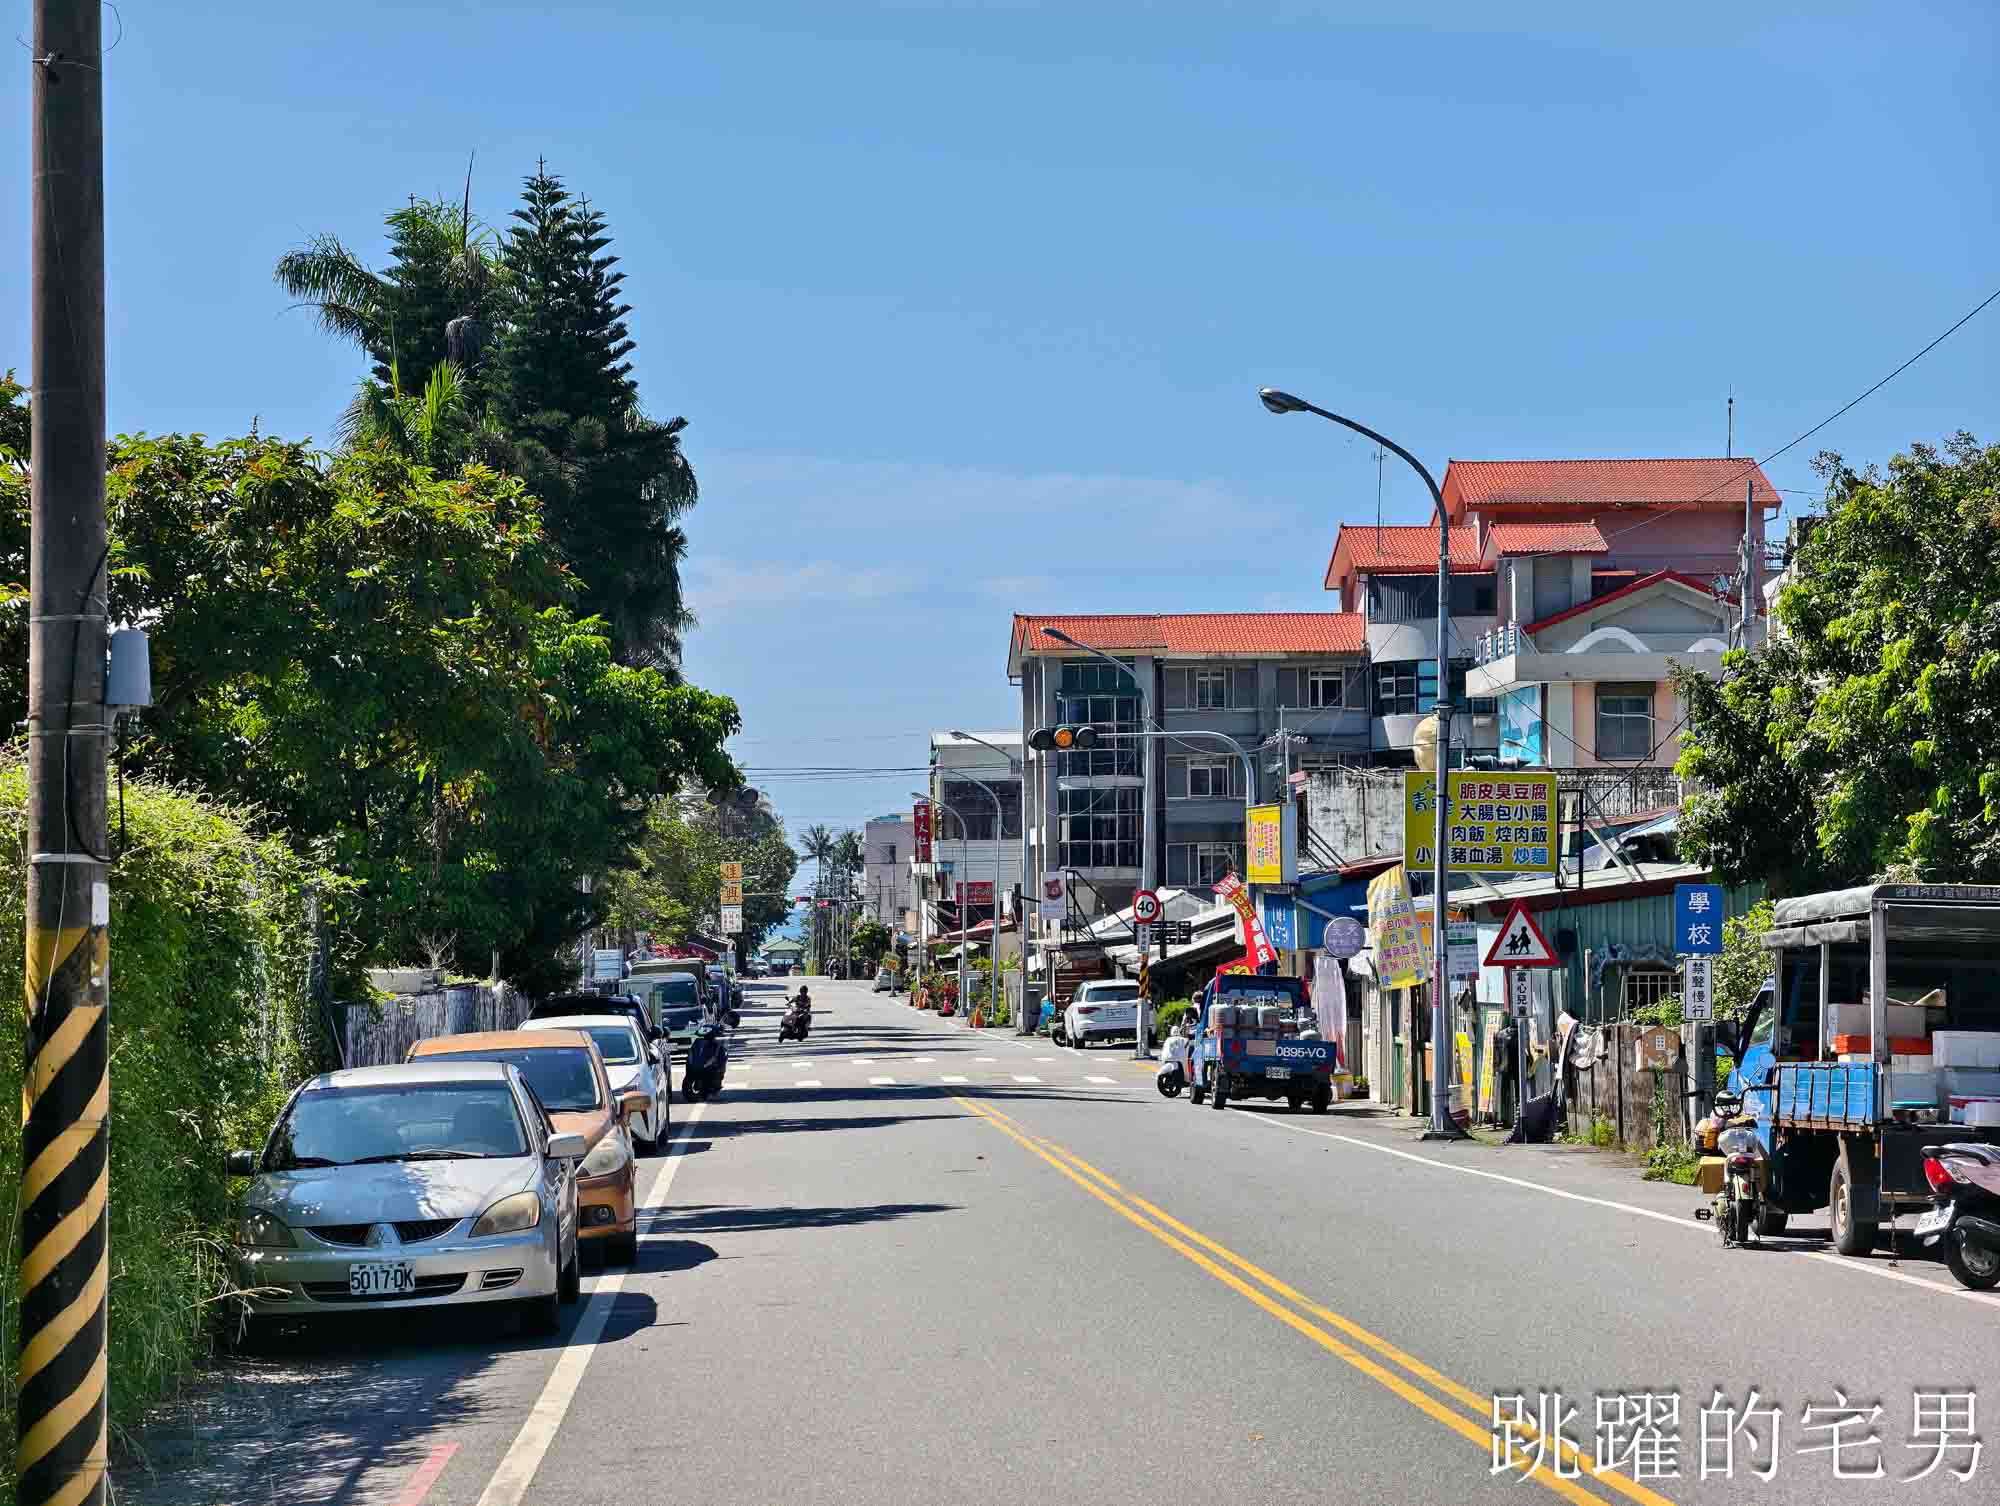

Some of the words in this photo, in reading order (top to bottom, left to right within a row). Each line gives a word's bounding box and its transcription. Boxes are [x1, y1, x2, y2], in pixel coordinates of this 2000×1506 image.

[1459, 783, 1547, 800] 脆皮臭豆腐
[1460, 805, 1547, 821] 大腸包小腸
[1416, 847, 1503, 864] 小豬血湯
[1137, 900, 1155, 914] 40
[1687, 892, 1711, 945] 學校
[1517, 971, 1528, 1017] 當心兒童
[1691, 961, 1705, 1018] 禁聲慢行
[350, 1268, 414, 1290] 5017-DK
